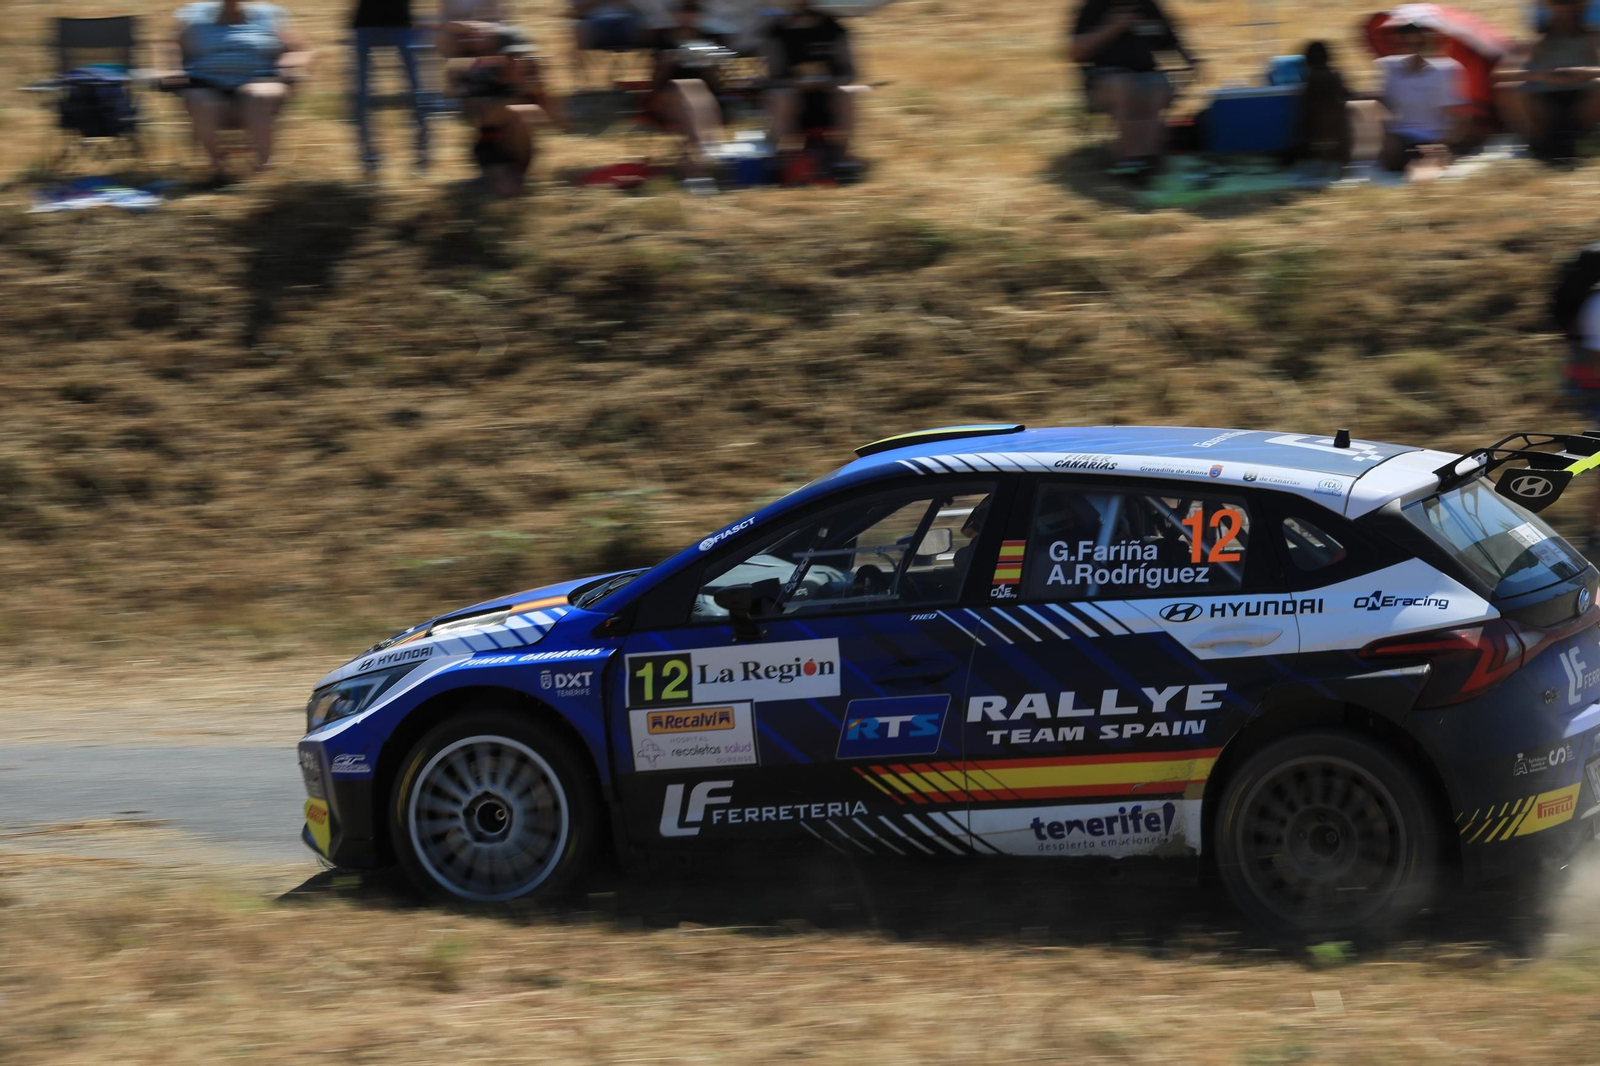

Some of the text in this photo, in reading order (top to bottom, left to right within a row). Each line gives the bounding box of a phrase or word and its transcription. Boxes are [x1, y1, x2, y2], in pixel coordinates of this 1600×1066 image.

[1054, 460, 1118, 470] CANARIAS
[1140, 466, 1175, 474] Granadilla
[1186, 468, 1208, 476] Abona
[1269, 477, 1301, 486] Canarias
[713, 516, 756, 543] FIASCT
[1181, 508, 1243, 564] 12
[1049, 540, 1158, 562] G.Fariña
[1047, 563, 1210, 589] A.Rodríguez
[909, 612, 938, 622] THEO
[1210, 598, 1324, 618] HYUNDAI
[377, 646, 434, 666] HYUNDAI
[518, 647, 605, 662] CANARIAS
[555, 671, 593, 689] DXT
[635, 659, 689, 701] 12
[697, 657, 836, 686] La Región
[557, 688, 591, 697] TENERIFE
[966, 683, 1228, 723] RALLYE
[665, 711, 717, 729] Recalvi
[846, 714, 940, 741] RTS
[670, 736, 708, 744] HOSPITAL
[986, 719, 1206, 745] TEAM SPAIN
[671, 741, 752, 757] recoletas salud
[659, 780, 868, 837] LF FERRETERIA
[1537, 794, 1573, 819] PIRELLI
[1038, 840, 1095, 852] despierta
